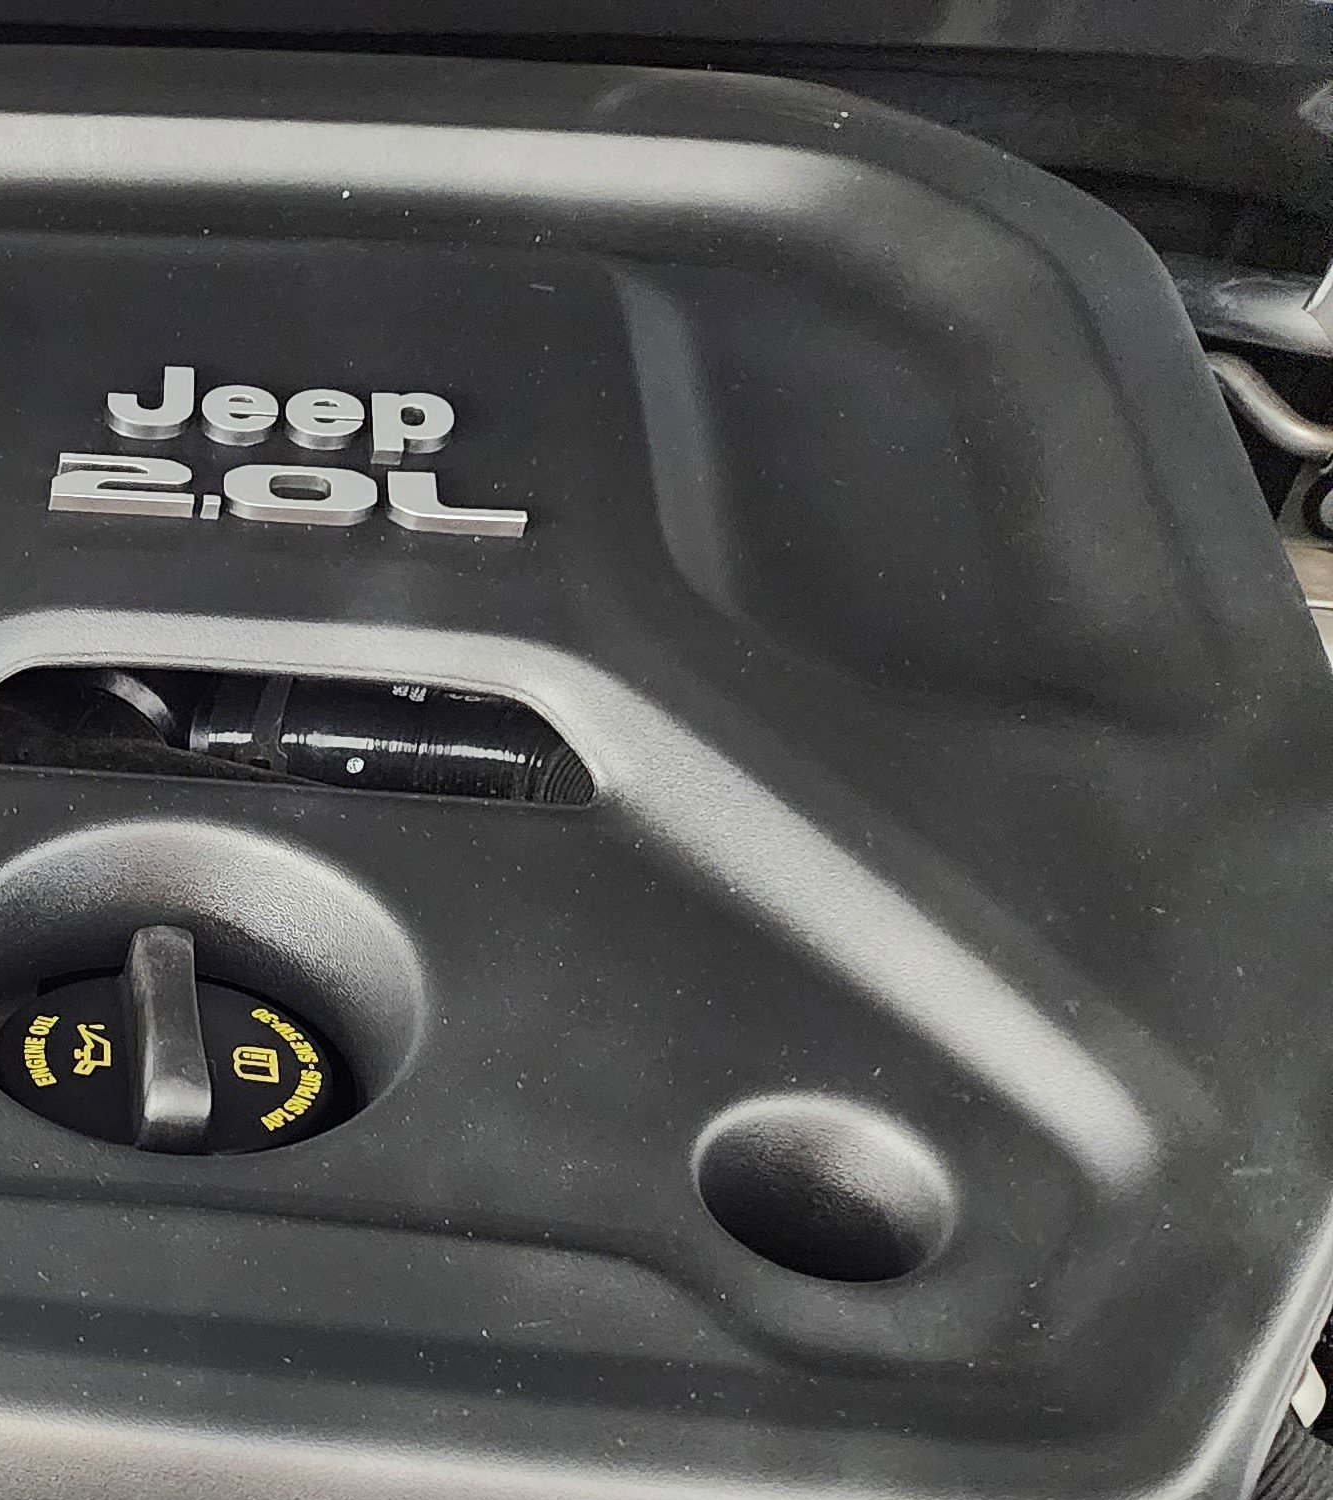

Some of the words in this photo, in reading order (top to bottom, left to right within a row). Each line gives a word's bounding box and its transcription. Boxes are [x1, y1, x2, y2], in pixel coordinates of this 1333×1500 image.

[105, 366, 455, 465] Jeep
[48, 452, 528, 538] 2.0L
[28, 1014, 61, 1037] OIL
[23, 1036, 58, 1087] ENGINE
[294, 1069, 323, 1101] PLUS
[260, 1107, 296, 1132] API
[283, 1094, 312, 1116] SN
